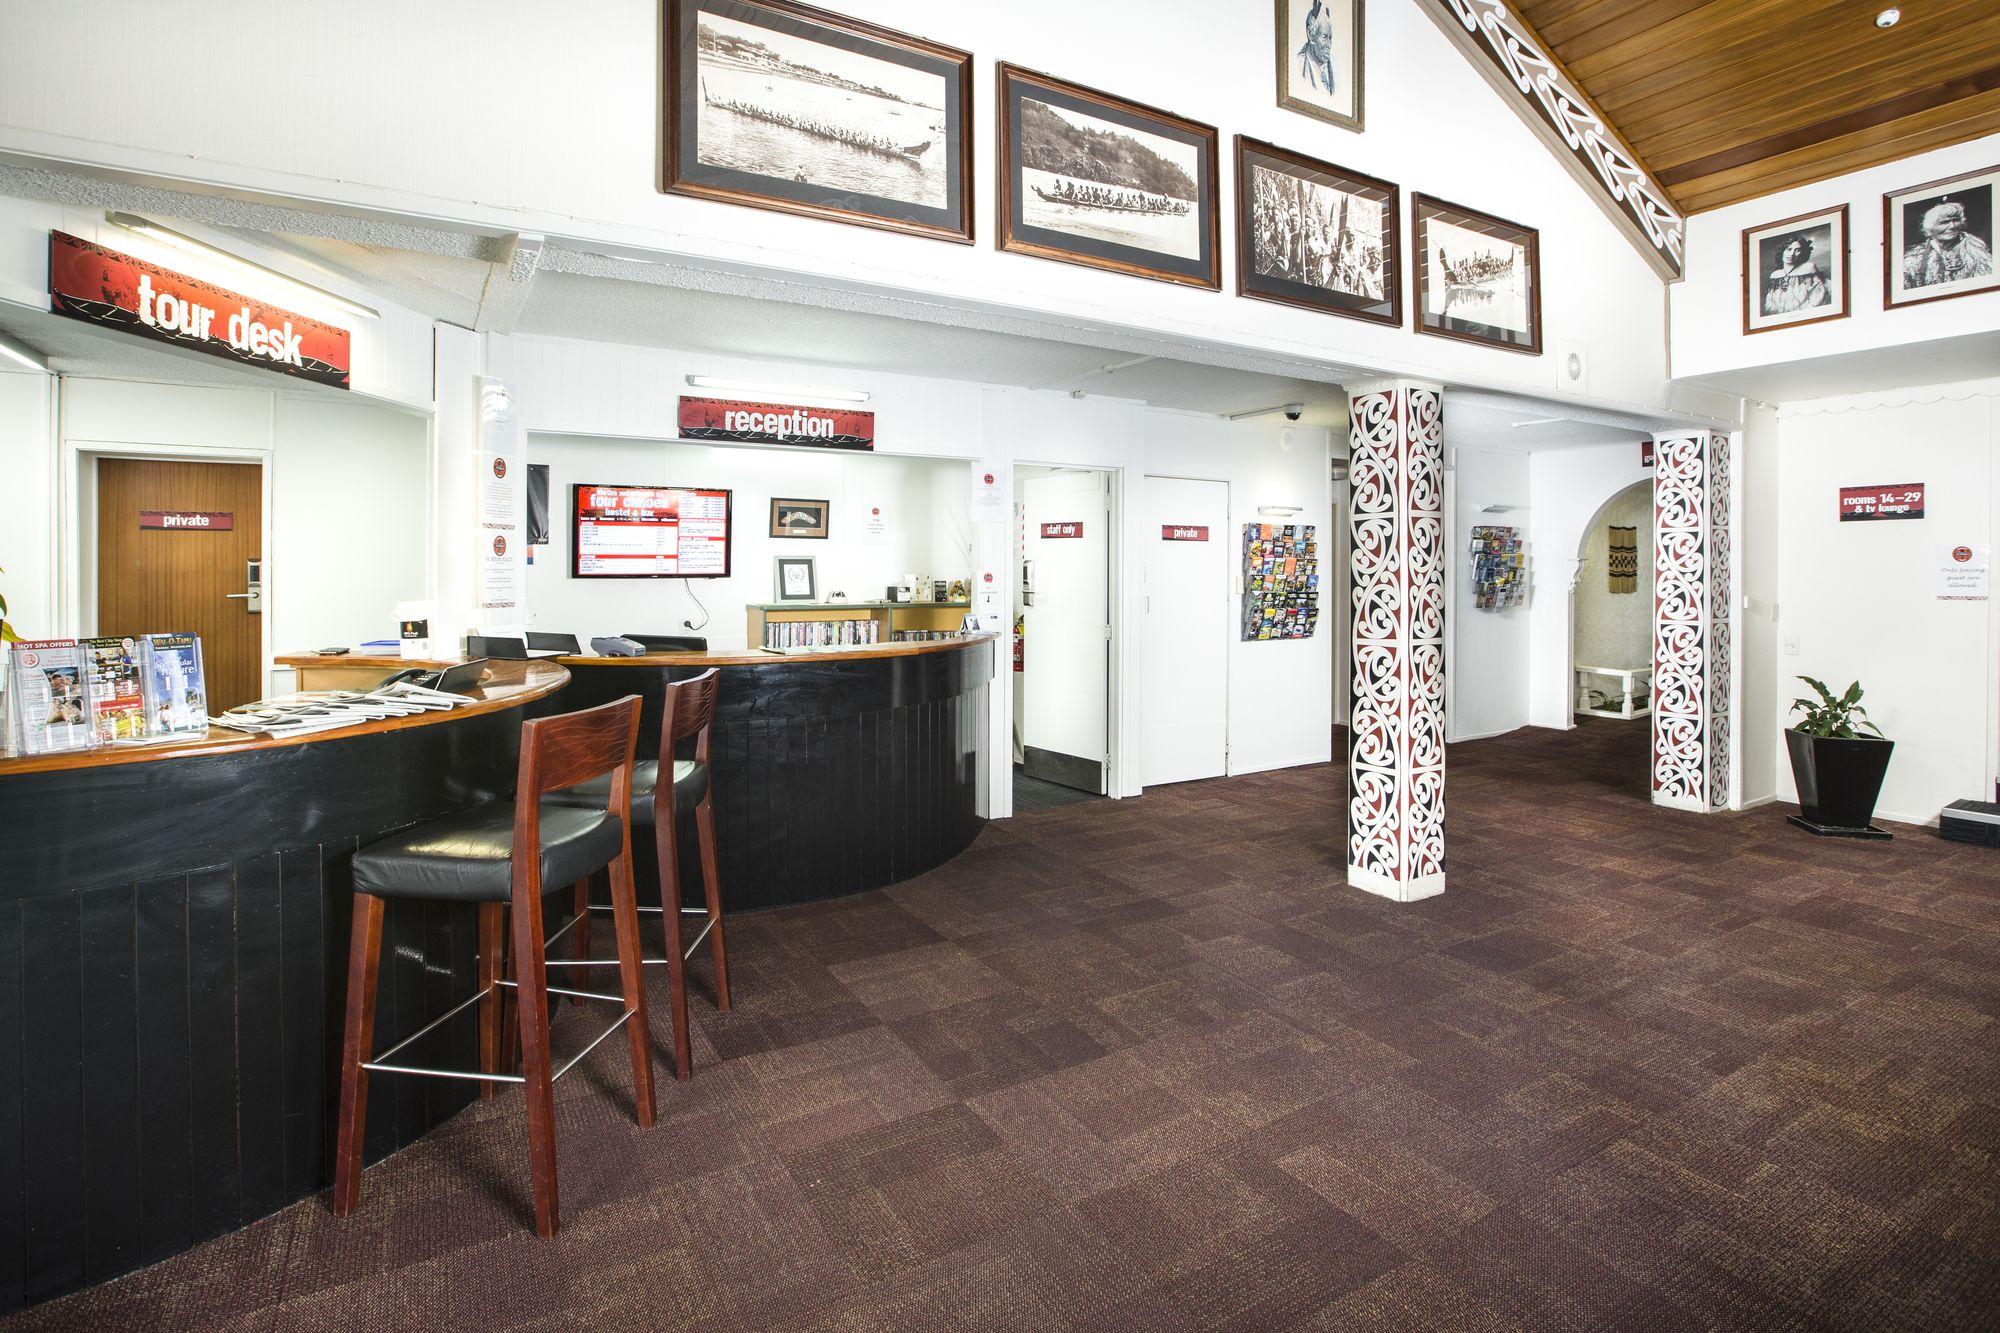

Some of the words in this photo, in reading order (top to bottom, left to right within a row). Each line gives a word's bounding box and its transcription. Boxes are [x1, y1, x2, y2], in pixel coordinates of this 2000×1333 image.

[138, 274, 216, 341] tour
[229, 305, 304, 367] desk
[725, 410, 834, 440] reception
[1843, 495, 1877, 506] rooms
[605, 508, 630, 516] hostel
[1854, 504, 1863, 513] &
[1866, 504, 1876, 513] tv
[1878, 503, 1910, 514] lounge
[163, 514, 210, 528] private
[1046, 524, 1062, 535] staff
[1062, 525, 1075, 536] only
[1174, 528, 1198, 539] private
